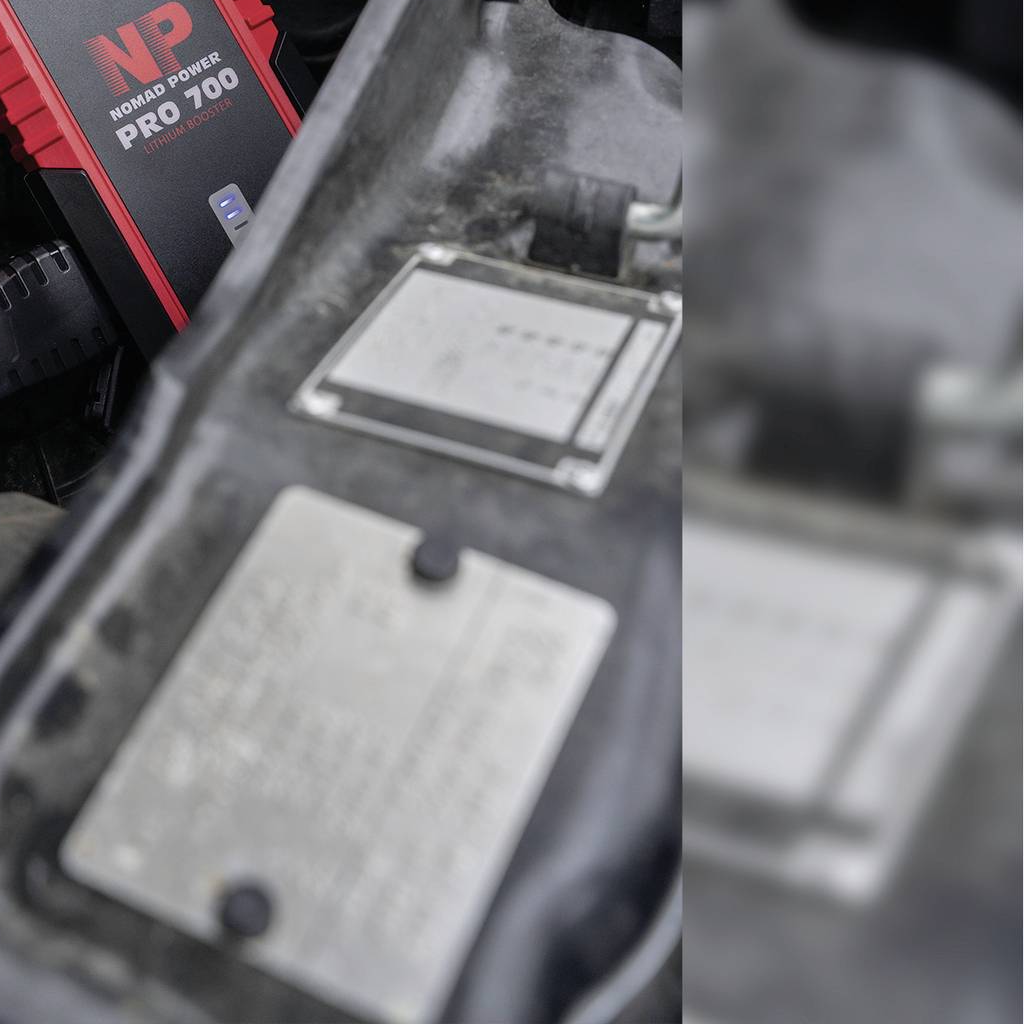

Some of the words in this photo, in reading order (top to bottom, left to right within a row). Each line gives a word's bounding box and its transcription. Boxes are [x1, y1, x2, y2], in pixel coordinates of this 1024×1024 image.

[83, 0, 193, 97] NP
[109, 83, 166, 121] NOMAD
[167, 51, 222, 88] POWER
[115, 101, 181, 150] PRO
[183, 67, 239, 110] 700
[143, 123, 187, 154] LITHIUM
[187, 97, 233, 130] BOOSTER
